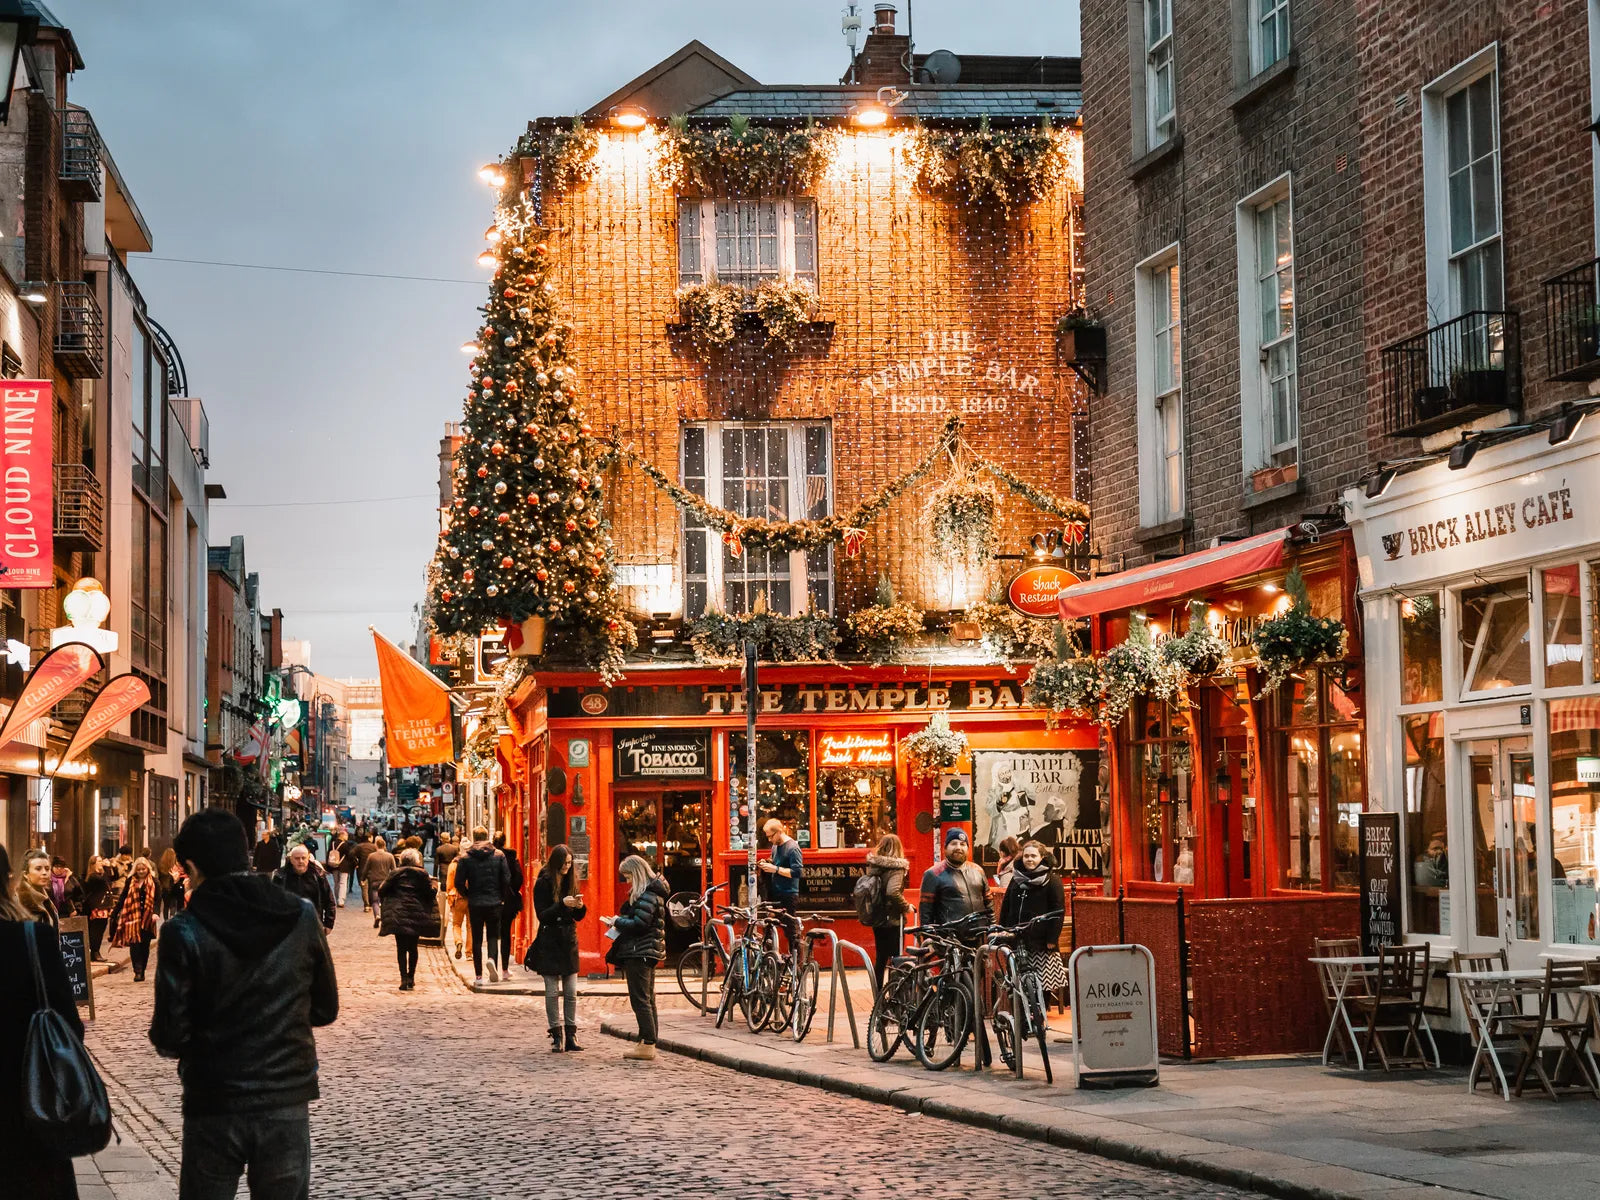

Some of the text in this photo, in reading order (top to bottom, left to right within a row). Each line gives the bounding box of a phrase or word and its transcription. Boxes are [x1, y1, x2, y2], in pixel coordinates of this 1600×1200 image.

[923, 331, 977, 351] THE
[860, 355, 1039, 396] TEMPLE BAR
[960, 397, 1008, 413] 1840
[4, 389, 39, 455] NINE
[5, 466, 39, 558] CLOUD
[1408, 478, 1574, 556] BRICK ALLEY CAFÉ
[1033, 575, 1062, 591] Shack
[1020, 593, 1060, 603] Restaur
[25, 675, 63, 708] CLOUD
[585, 697, 602, 709] 48
[799, 688, 951, 712] TEMPLE
[87, 703, 119, 731] CLOUD
[408, 719, 430, 728] THE
[393, 725, 447, 741] TEMPLE
[823, 733, 889, 749] Traditional
[408, 738, 436, 750] BAR
[617, 733, 656, 750] Importers
[628, 749, 698, 772] TOBACCO
[822, 748, 893, 764] Irish Music
[1010, 759, 1077, 771] TEMPLE
[1031, 772, 1062, 784] BAR
[1366, 826, 1391, 841] BRICK
[1366, 842, 1392, 856] ALLEY
[802, 866, 846, 878] EMPLE
[1086, 981, 1142, 999] ARIOSA
